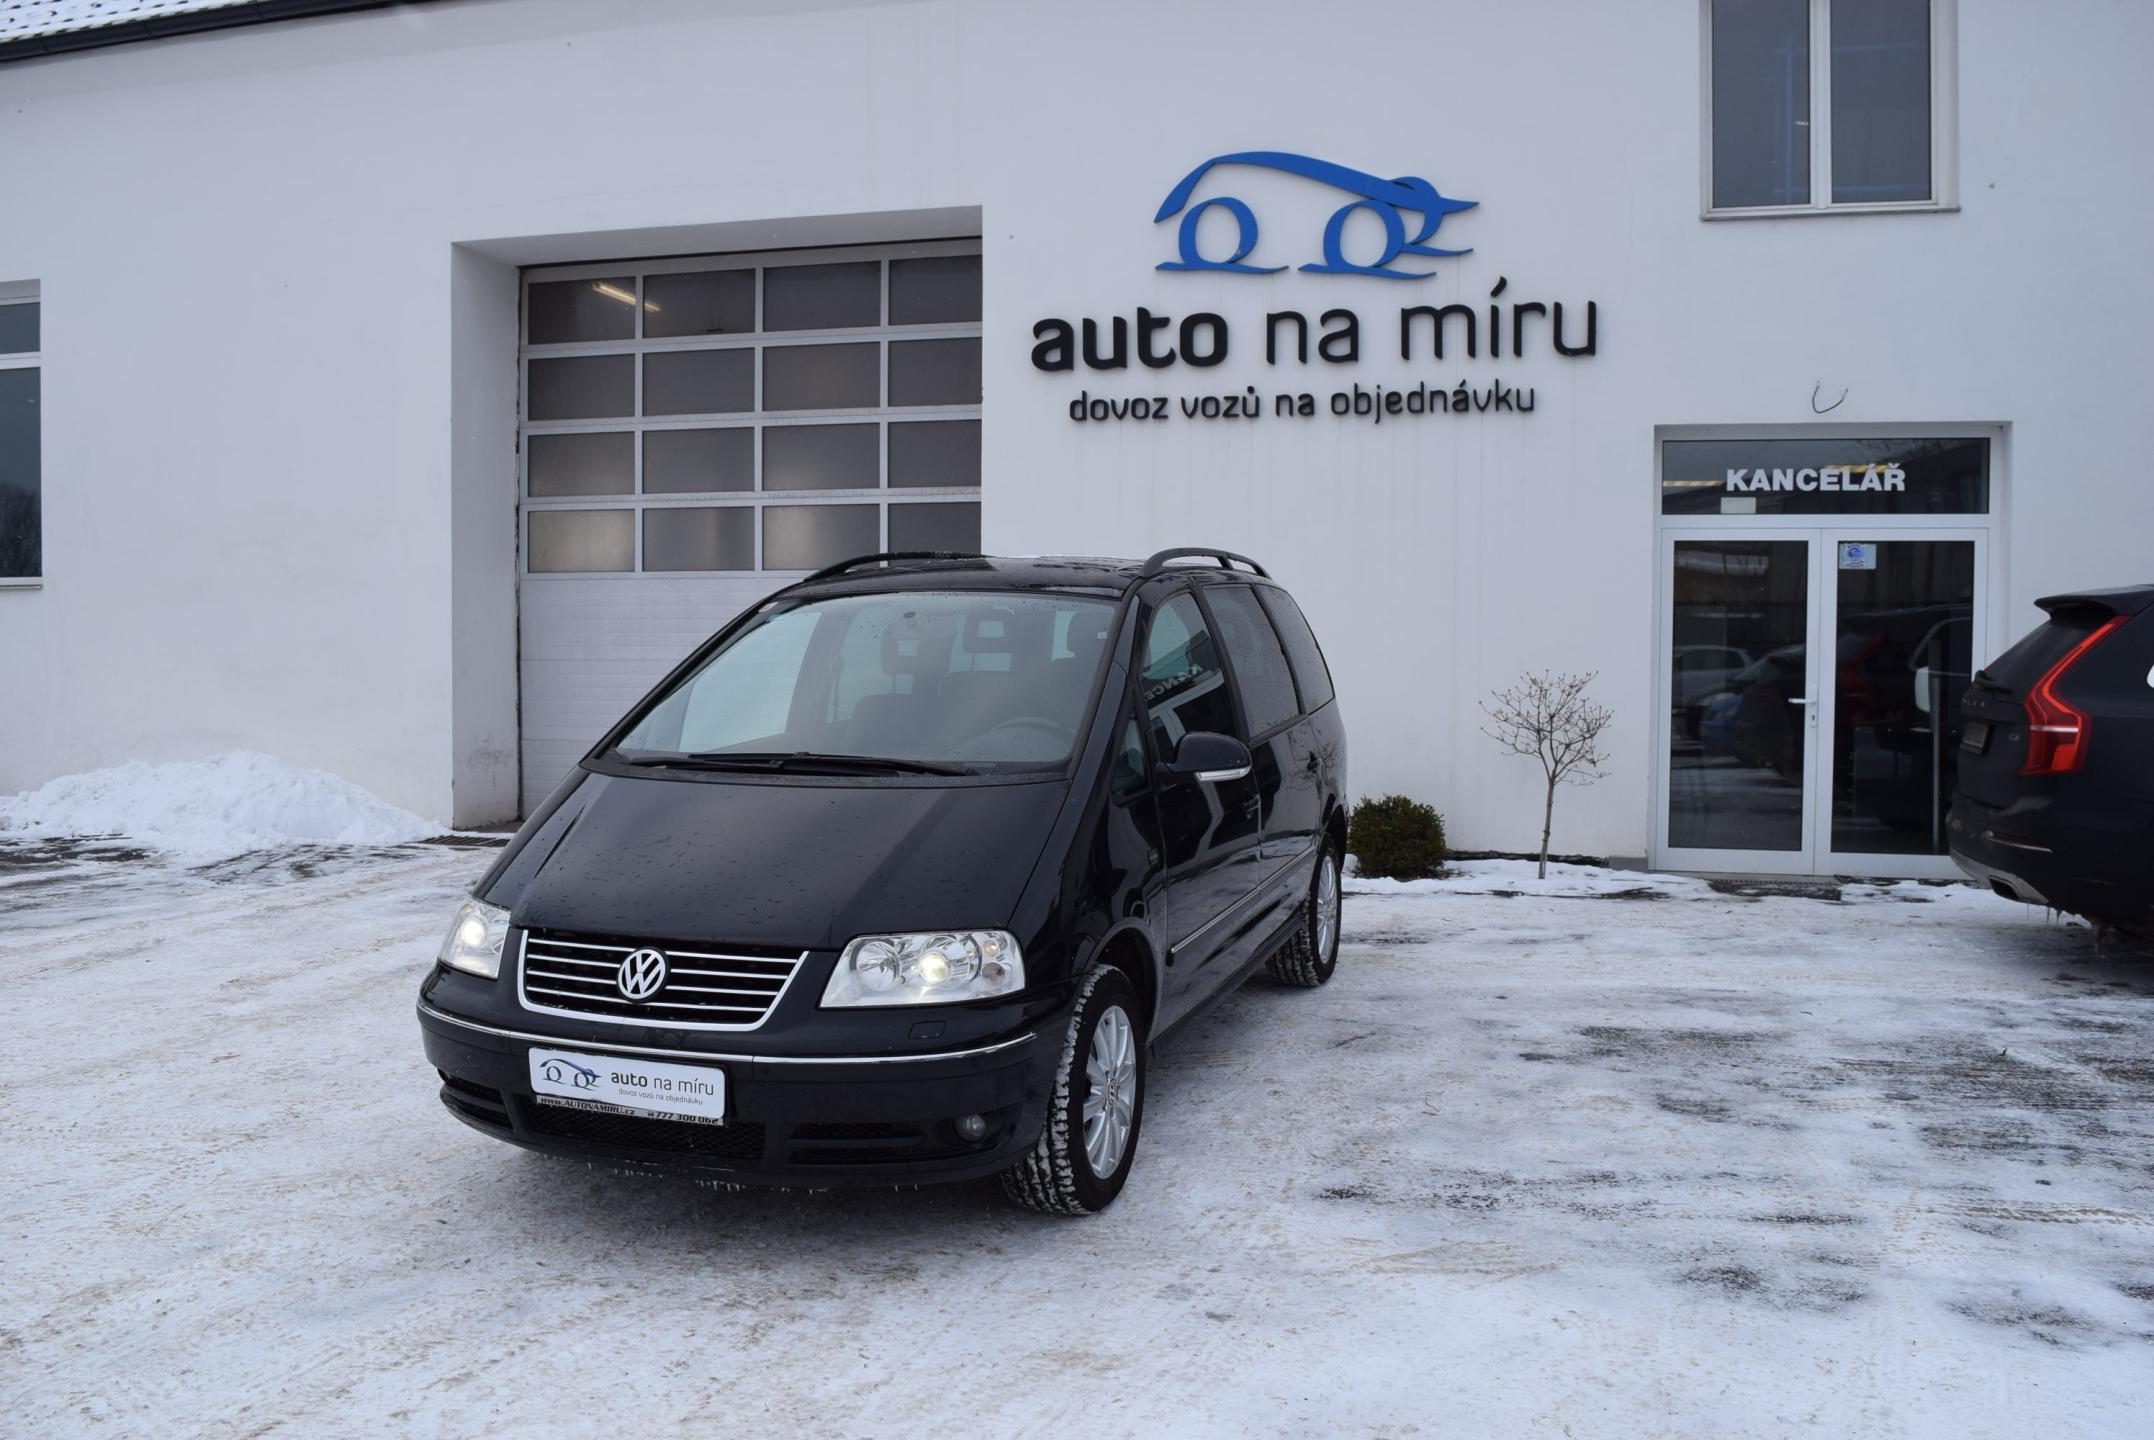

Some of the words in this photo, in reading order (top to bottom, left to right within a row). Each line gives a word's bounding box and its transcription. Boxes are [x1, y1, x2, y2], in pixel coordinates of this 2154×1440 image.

[1031, 306, 1229, 372] auto
[1266, 308, 1360, 366] na
[1401, 276, 1598, 361] míru
[1069, 390, 1169, 422] dovoz
[1181, 385, 1261, 420] vozů
[1276, 391, 1316, 417] na
[1330, 379, 1536, 424] objednávku
[1726, 462, 1906, 492] KANCELÁŘ
[610, 1071, 648, 1088] auto
[653, 1077, 672, 1091] na
[678, 1077, 714, 1096] míru
[618, 1087, 637, 1097] dovoz
[655, 1093, 664, 1101] na
[665, 1093, 704, 1106] objednávku
